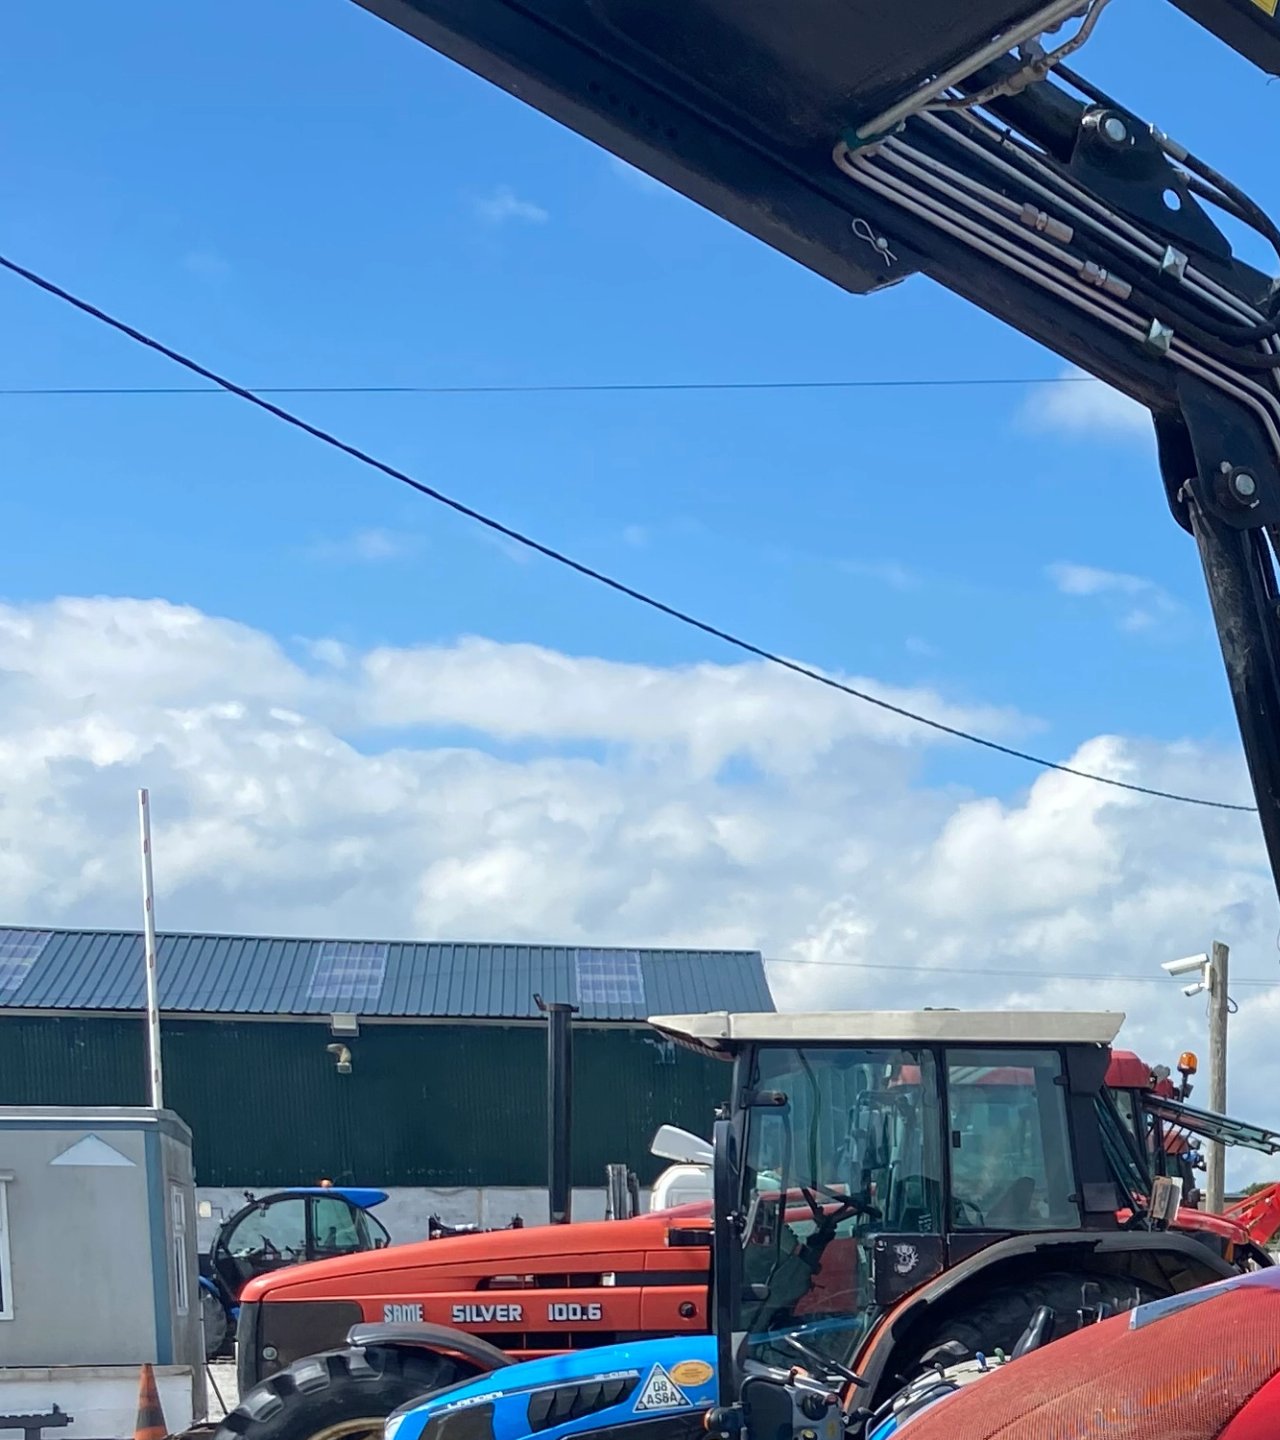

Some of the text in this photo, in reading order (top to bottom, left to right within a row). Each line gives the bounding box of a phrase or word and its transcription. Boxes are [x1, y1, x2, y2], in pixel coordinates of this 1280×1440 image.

[383, 1302, 602, 1323] SAME SILVER 100.6
